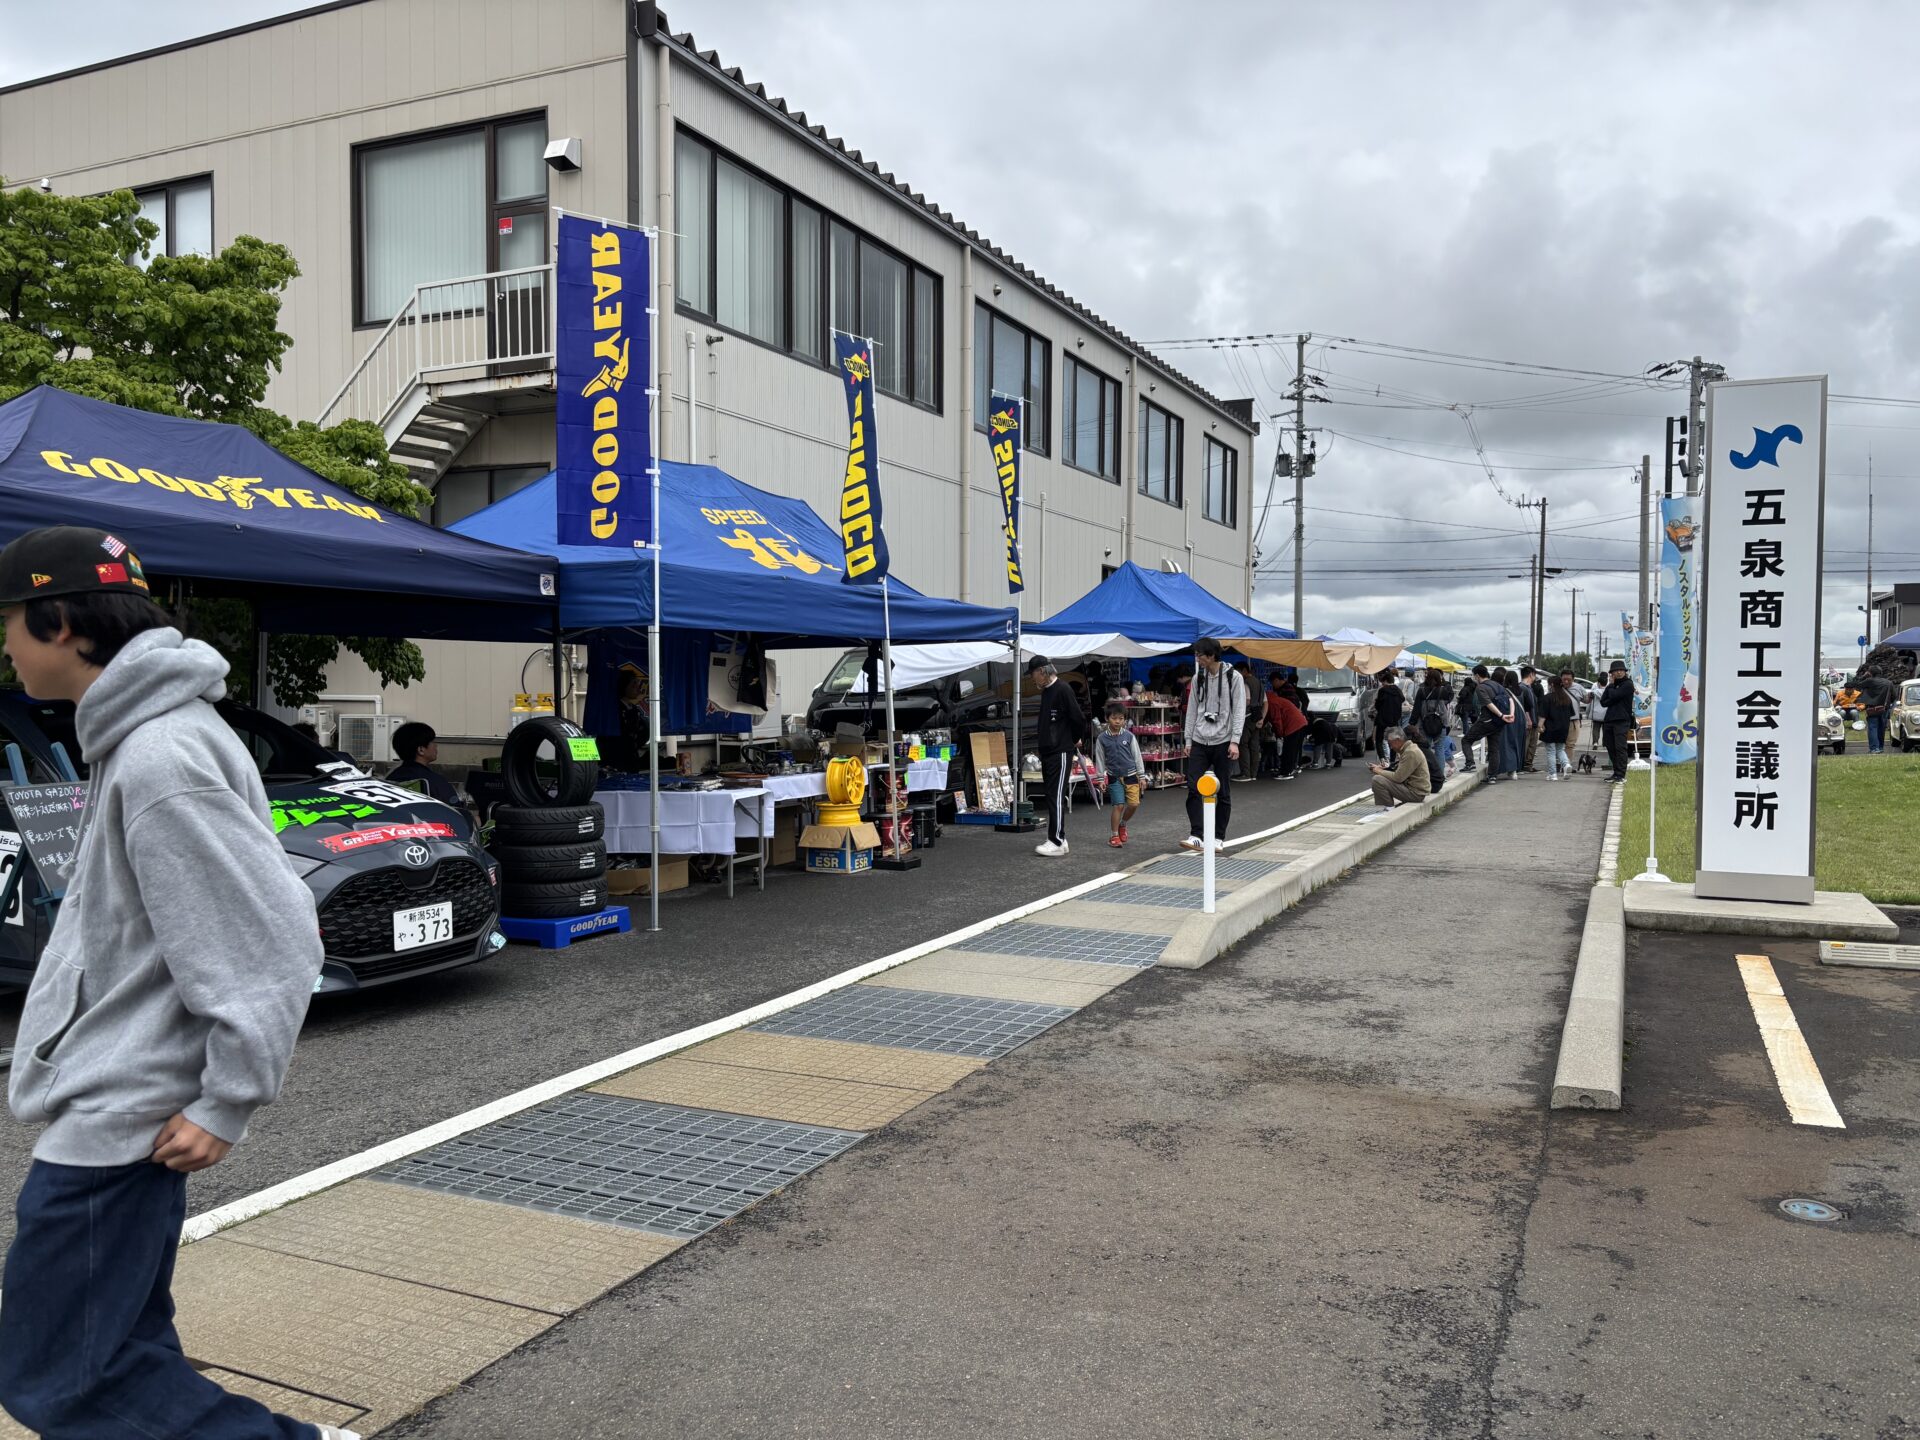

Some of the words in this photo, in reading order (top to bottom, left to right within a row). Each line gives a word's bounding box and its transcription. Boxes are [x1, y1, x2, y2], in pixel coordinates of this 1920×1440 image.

[700, 507, 768, 526] SPEED
[1733, 488, 1787, 831] 五泉商工会議所
[8, 789, 43, 804] TOYOTA
[297, 796, 341, 805] SHOP
[382, 826, 427, 837] Yaris
[815, 856, 839, 868] ESR
[854, 856, 869, 869] ESR
[408, 907, 441, 923] 新潟534
[570, 914, 618, 933] GOODYEAR
